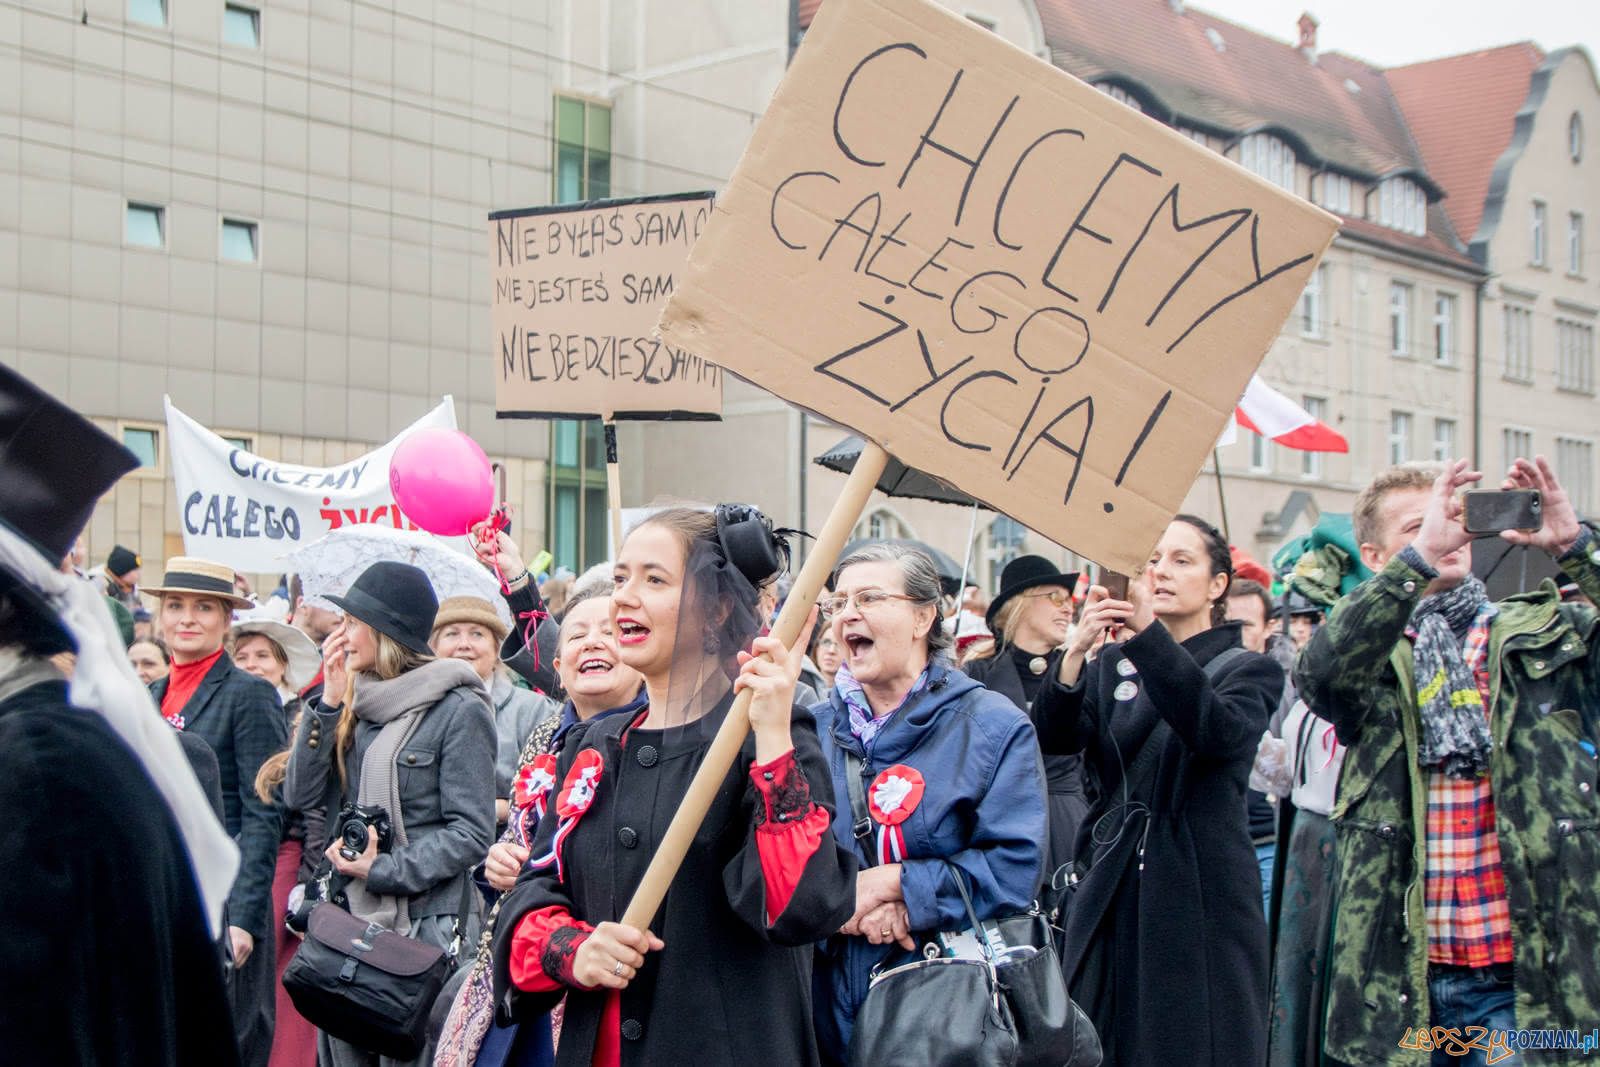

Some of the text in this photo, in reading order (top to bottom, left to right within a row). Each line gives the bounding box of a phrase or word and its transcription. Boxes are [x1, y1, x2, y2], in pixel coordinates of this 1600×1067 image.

[833, 42, 1314, 354] CHCEMY
[497, 217, 540, 267] NIE
[548, 207, 624, 258] BYŁAŚ
[496, 272, 673, 309] NIE JESTEŚ SAM
[770, 171, 1090, 375] CAŁEGO
[501, 325, 547, 383] NIE
[184, 491, 301, 541] CAŁEGO
